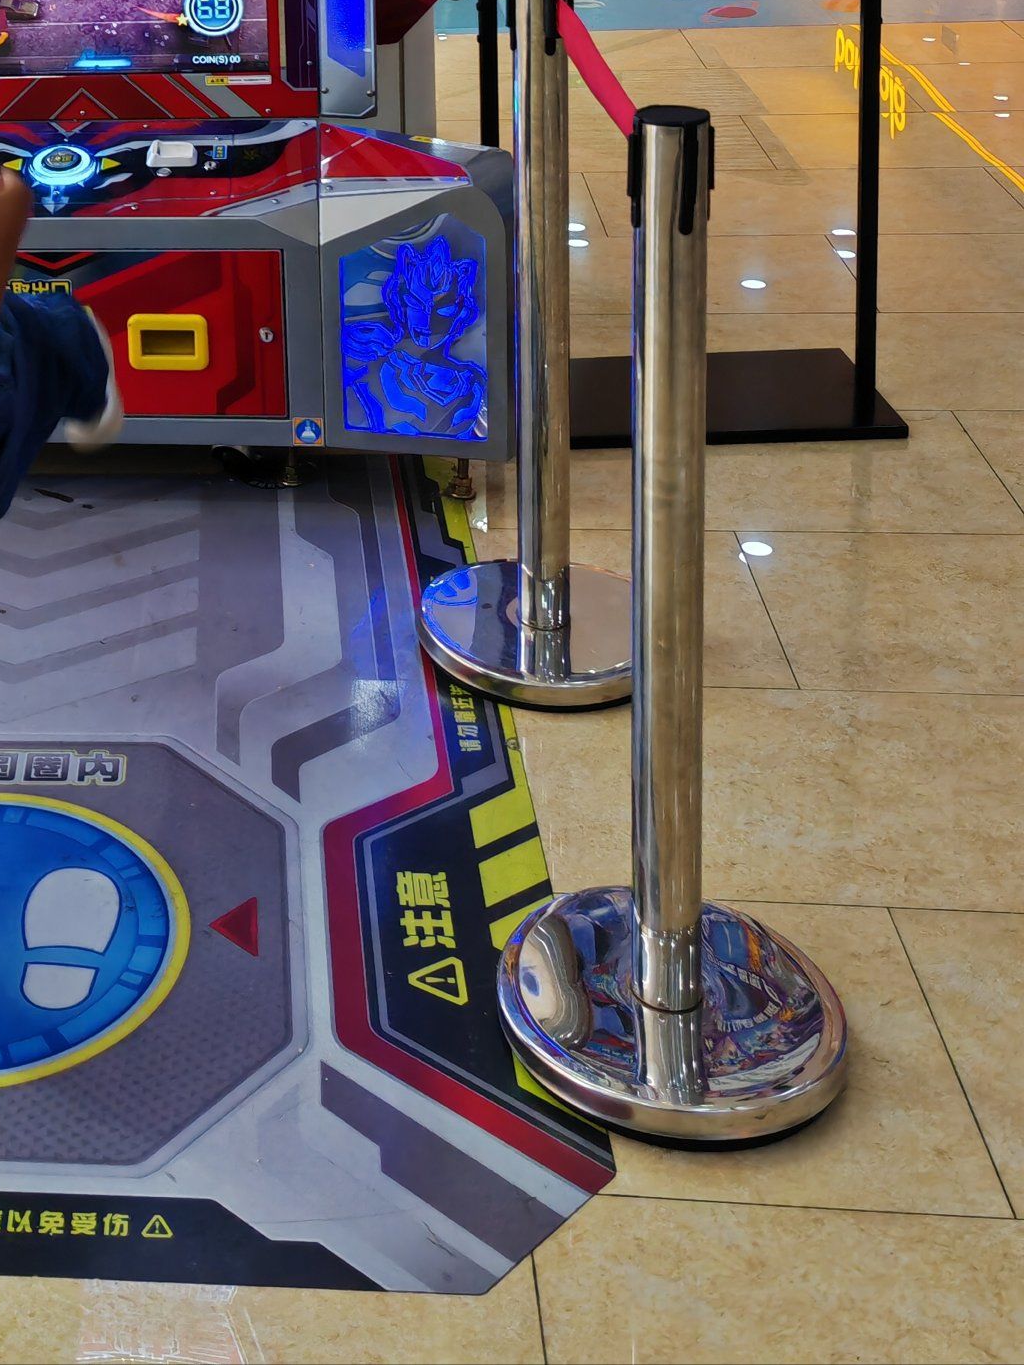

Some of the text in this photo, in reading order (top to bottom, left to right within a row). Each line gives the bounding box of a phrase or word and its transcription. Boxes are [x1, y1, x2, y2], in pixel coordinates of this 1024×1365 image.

[192, 55, 241, 65] COIN(S) 00
[396, 871, 457, 949] 注意
